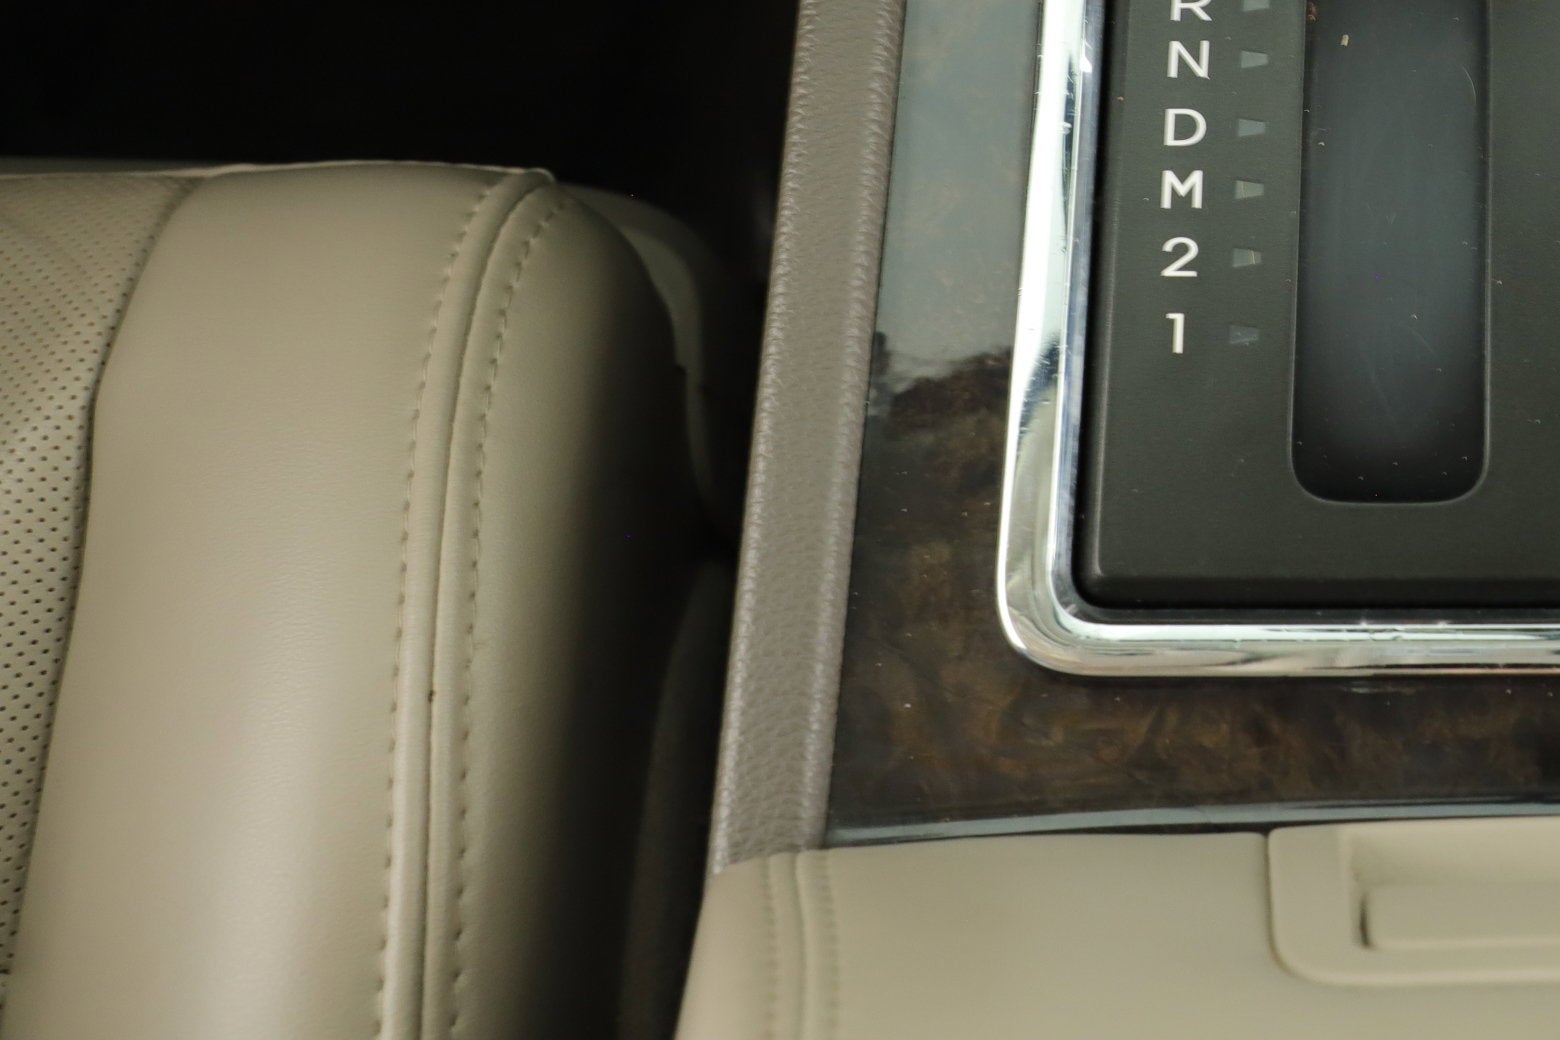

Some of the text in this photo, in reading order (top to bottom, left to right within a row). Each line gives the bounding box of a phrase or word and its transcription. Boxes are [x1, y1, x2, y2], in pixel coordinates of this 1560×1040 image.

[1167, 40, 1211, 80] N
[1163, 108, 1207, 147] D
[1160, 170, 1204, 209] M
[1160, 236, 1199, 277] 2
[1165, 312, 1186, 354] 1
